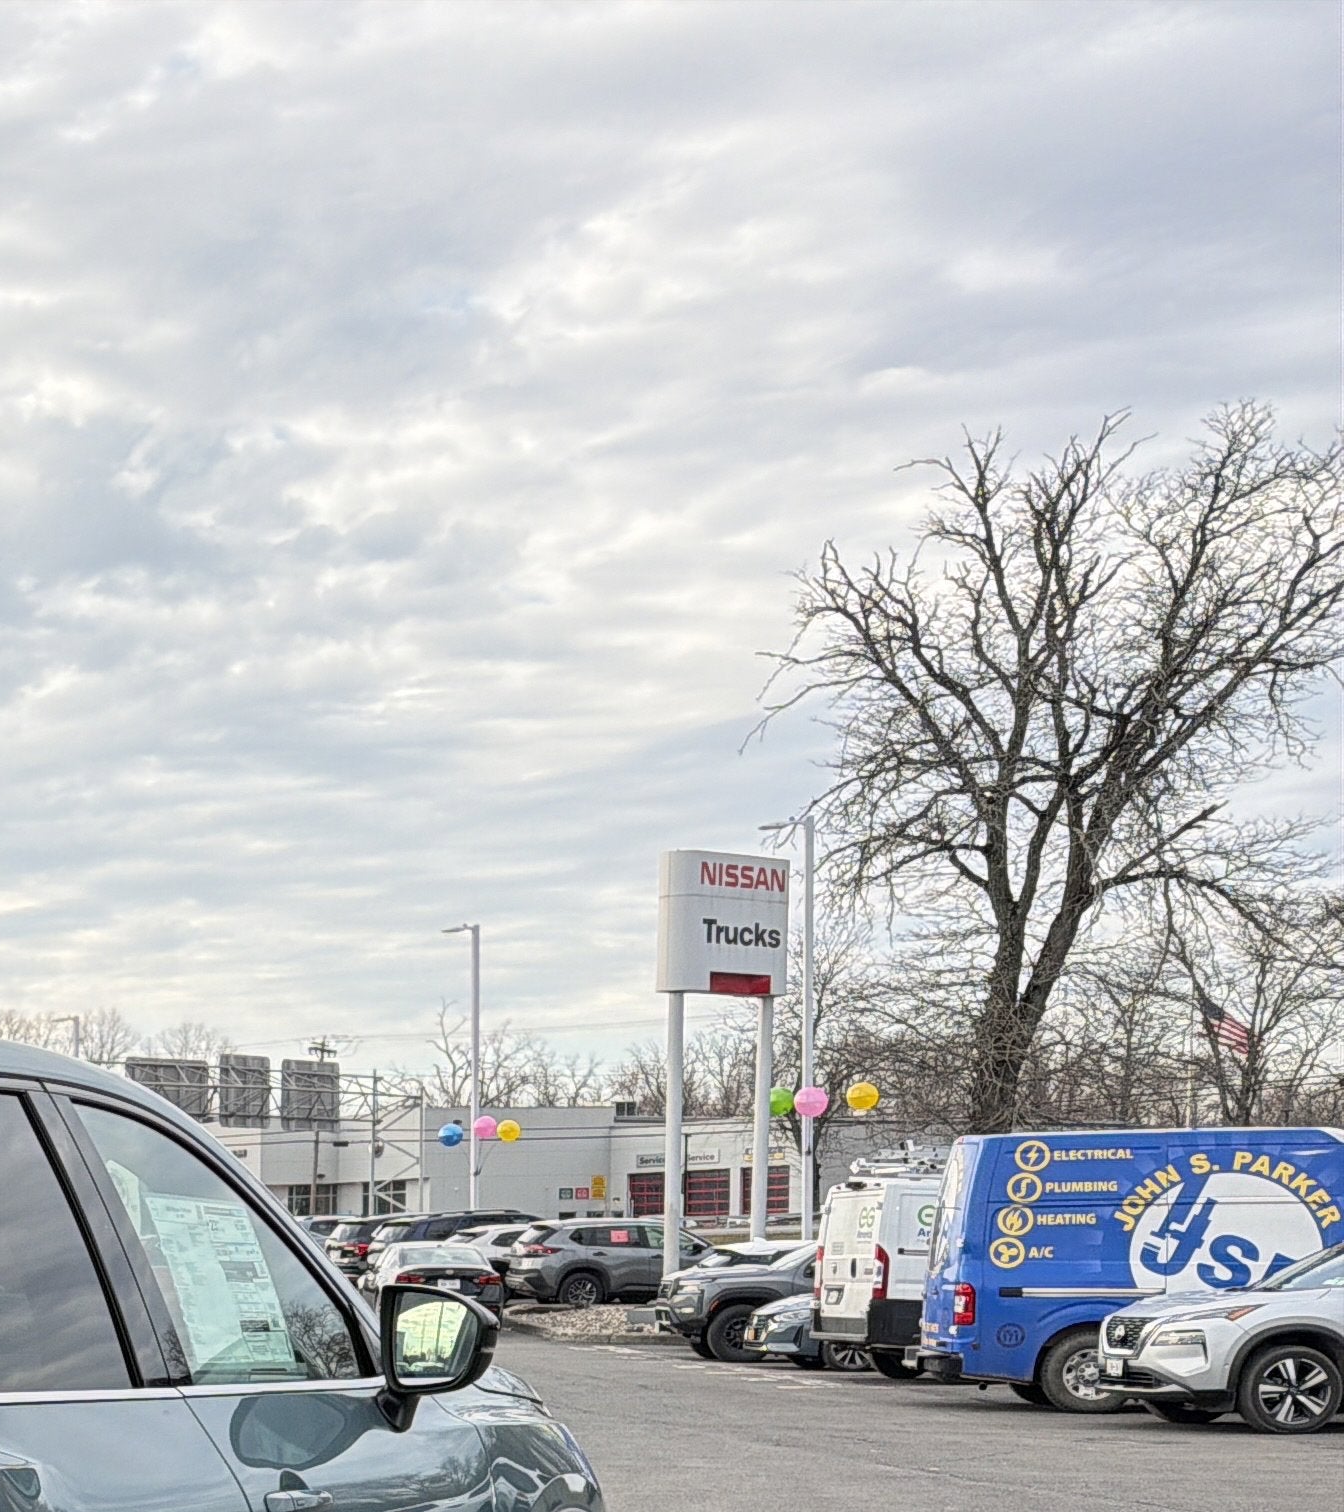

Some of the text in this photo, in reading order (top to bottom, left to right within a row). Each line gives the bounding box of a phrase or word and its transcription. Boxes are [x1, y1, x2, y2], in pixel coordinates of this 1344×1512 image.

[700, 861, 786, 892] NISSAN
[702, 918, 781, 948] Trucks
[639, 1155, 665, 1165] Servic
[1053, 1149, 1134, 1161] ELECTRICAL
[1045, 1181, 1118, 1193] PLUMBING
[1113, 1151, 1341, 1232] JOHN S. PARKER
[1036, 1214, 1097, 1225] HEATING
[1028, 1246, 1054, 1258] A/C
